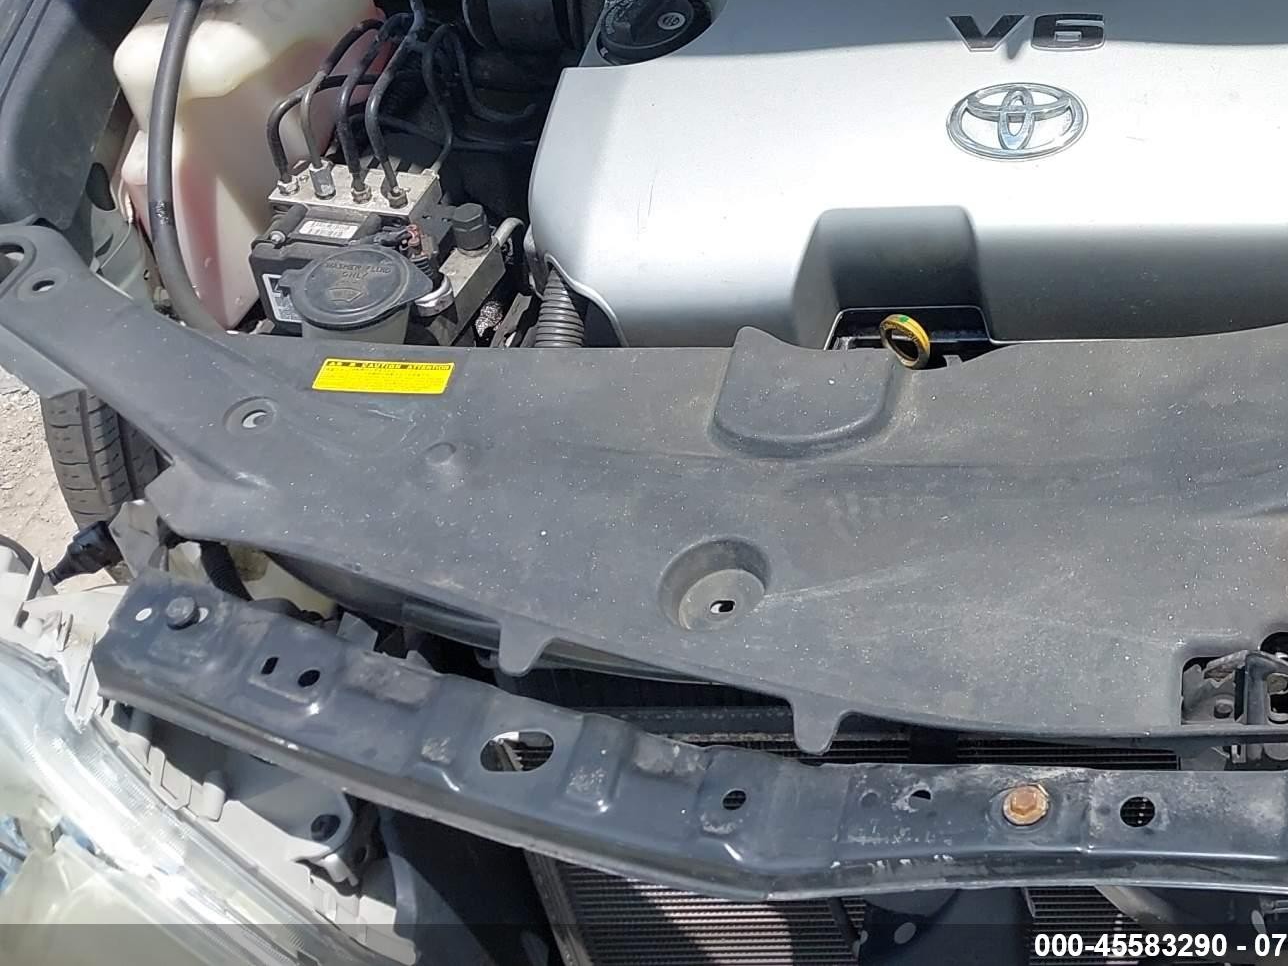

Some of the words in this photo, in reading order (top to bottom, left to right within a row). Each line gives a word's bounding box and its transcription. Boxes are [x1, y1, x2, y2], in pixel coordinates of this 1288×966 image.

[946, 13, 1104, 52] V6
[342, 271, 368, 279] ONLY
[361, 362, 402, 370] CAUTION
